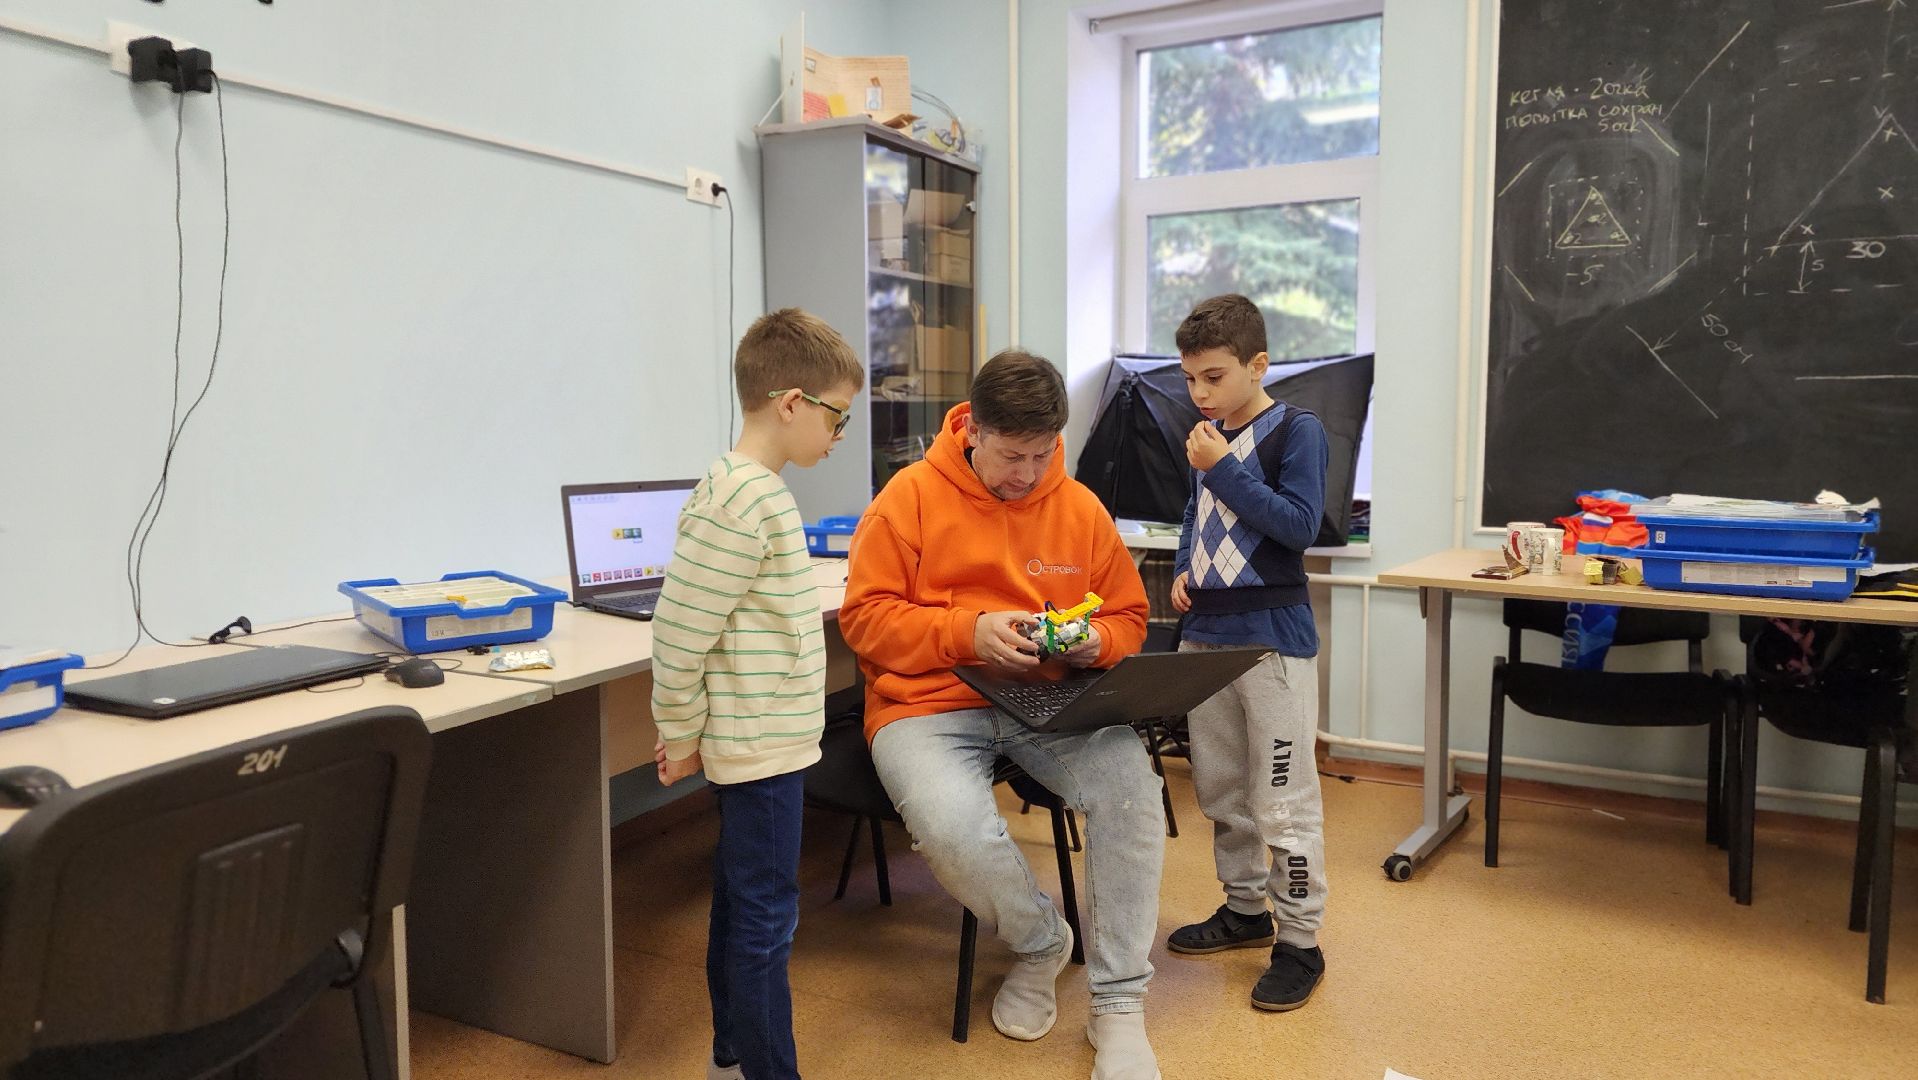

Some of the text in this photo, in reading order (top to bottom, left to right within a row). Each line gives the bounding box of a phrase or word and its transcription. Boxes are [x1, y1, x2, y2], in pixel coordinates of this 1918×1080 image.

[1845, 241, 1887, 258] 30
[237, 744, 289, 776] 201
[1270, 738, 1293, 788] ONLY
